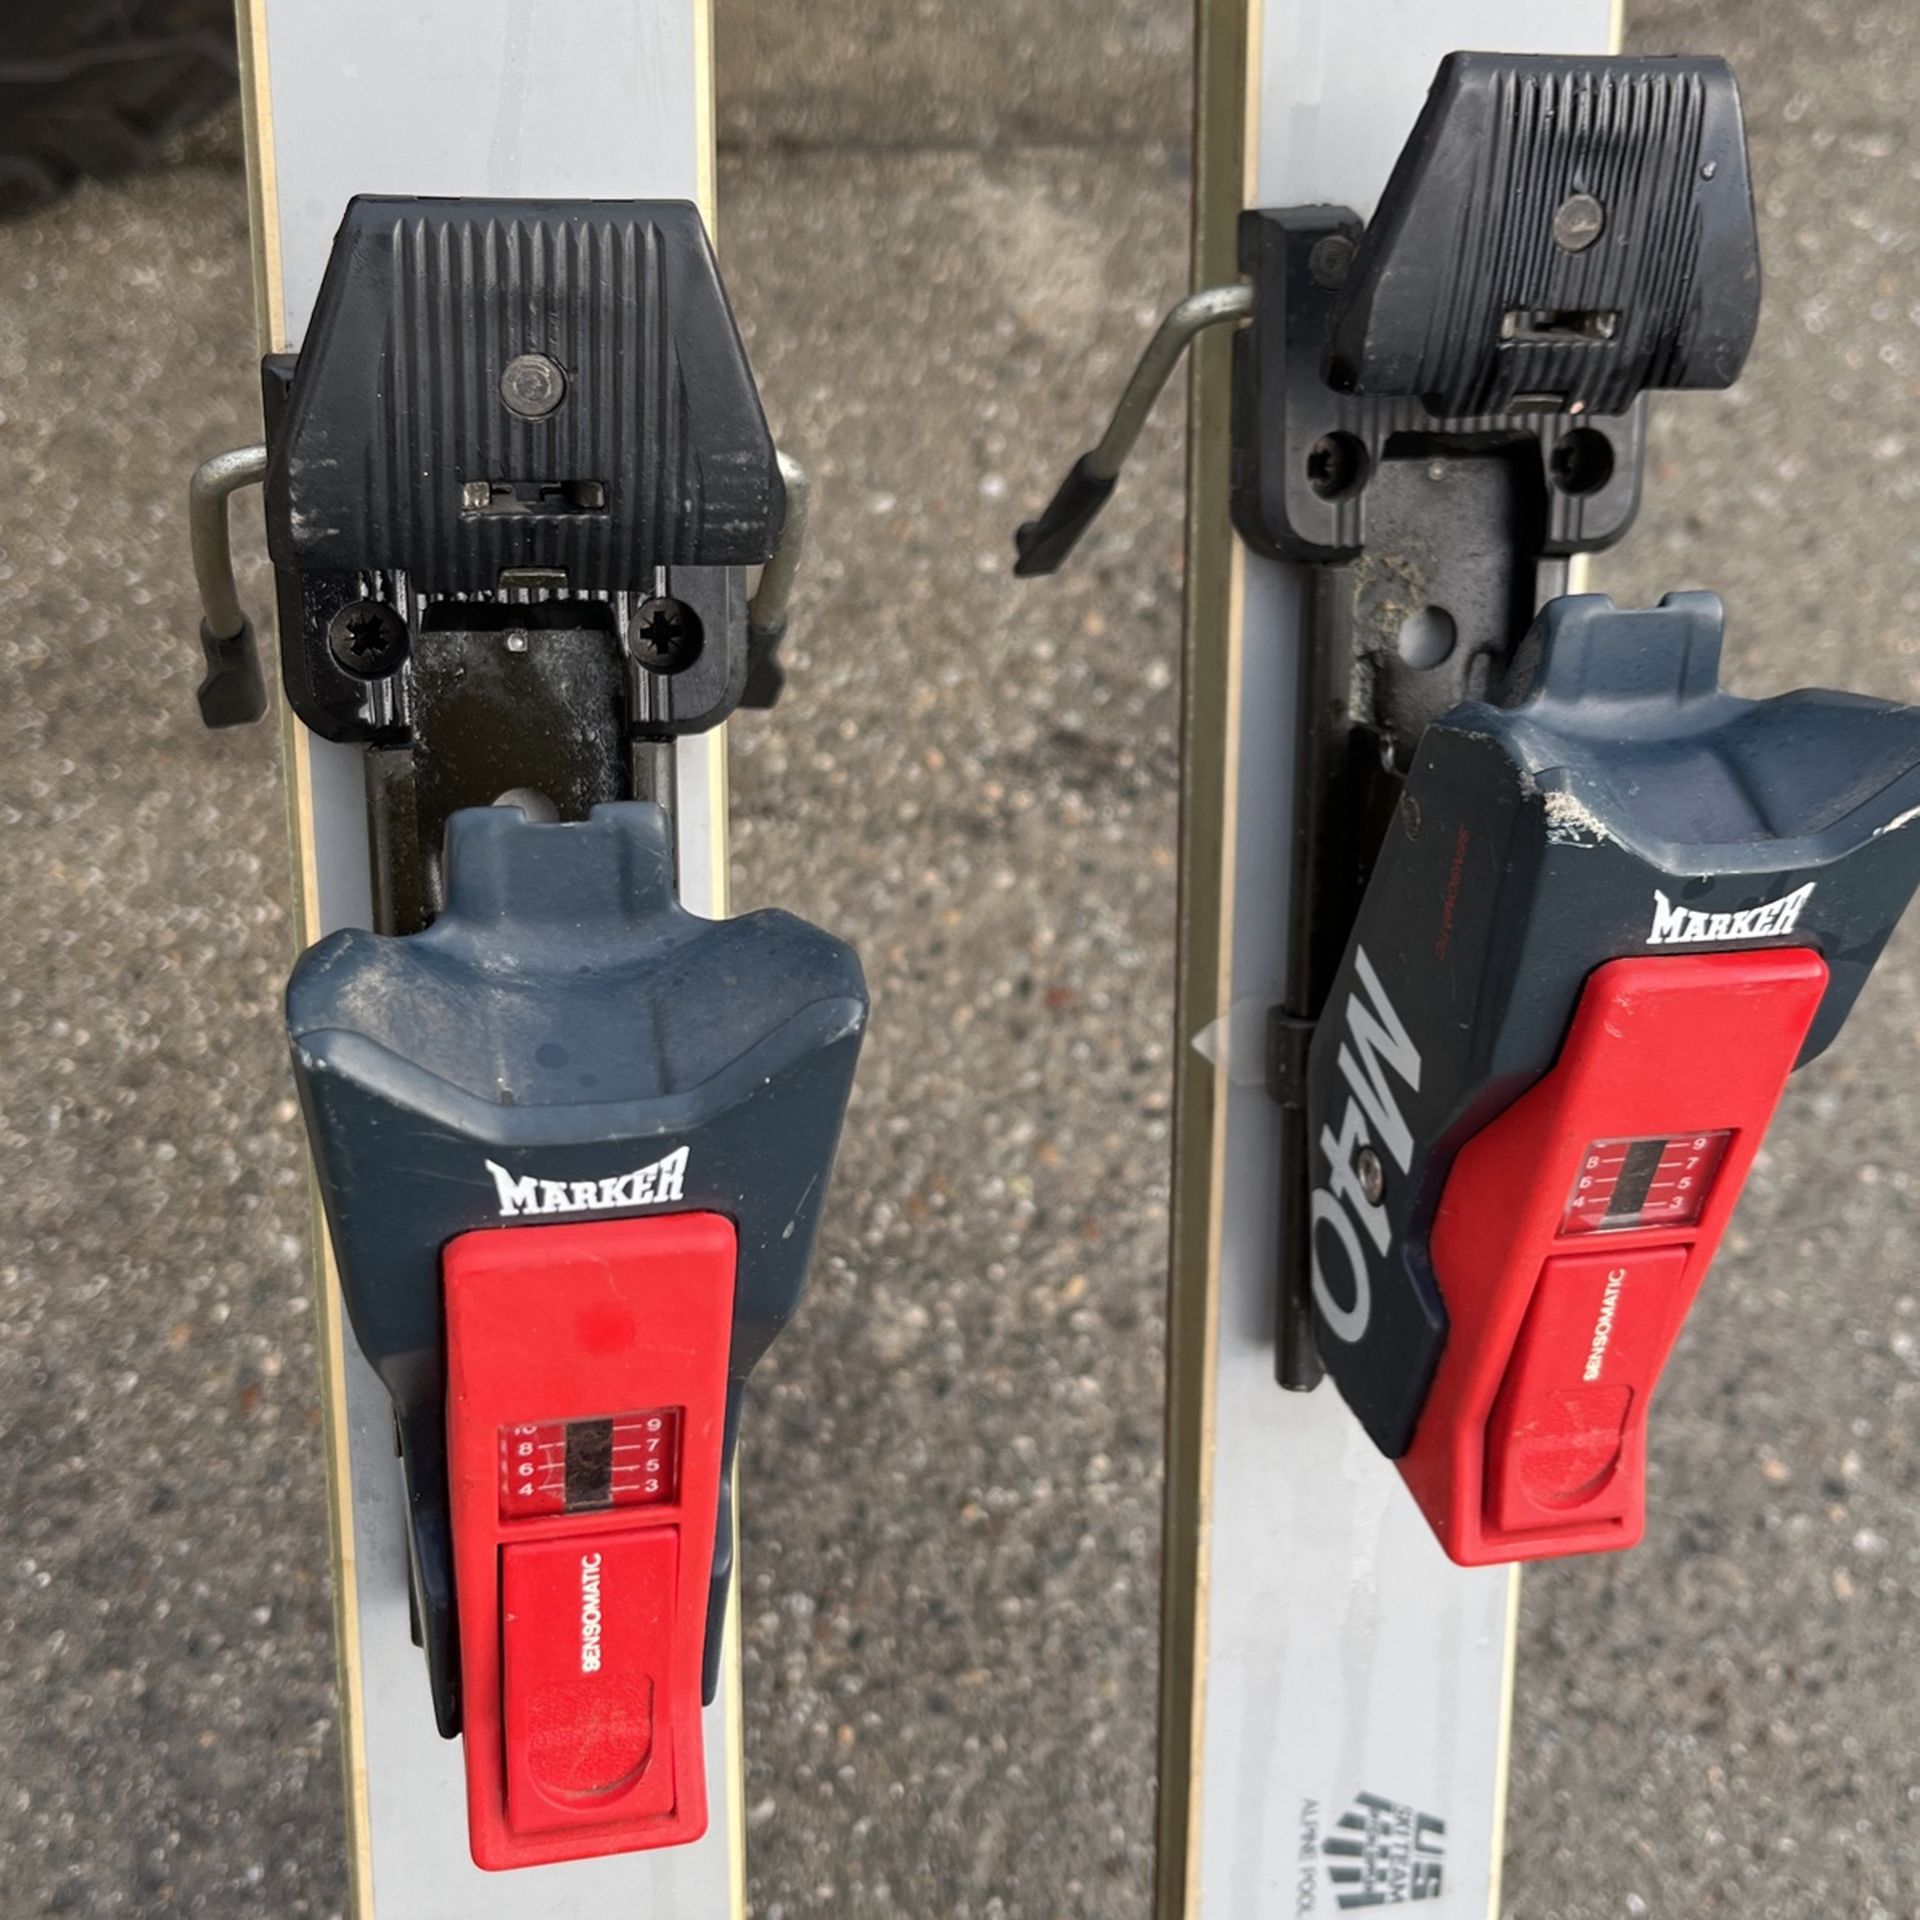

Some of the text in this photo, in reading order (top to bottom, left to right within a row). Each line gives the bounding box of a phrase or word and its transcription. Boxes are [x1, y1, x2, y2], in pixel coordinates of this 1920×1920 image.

[1646, 881, 1817, 944] MARKER
[1311, 944, 1422, 1342] M40
[1693, 1138, 1707, 1150] 9
[1686, 1157, 1699, 1170] 7
[484, 1145, 691, 1216] MARKER
[1579, 1176, 1692, 1189] 6 5
[1572, 1196, 1684, 1209] 4 3
[1582, 1268, 1626, 1382] SENSOMATIC
[647, 1418, 662, 1431] 9
[518, 1438, 661, 1456] 8 7
[518, 1458, 660, 1476] 6 5
[519, 1479, 659, 1496] 4 3
[581, 1552, 602, 1672] SENSOMATIC
[1299, 1798, 1318, 1861] ALPINE
[1410, 1811, 1446, 1901] US
